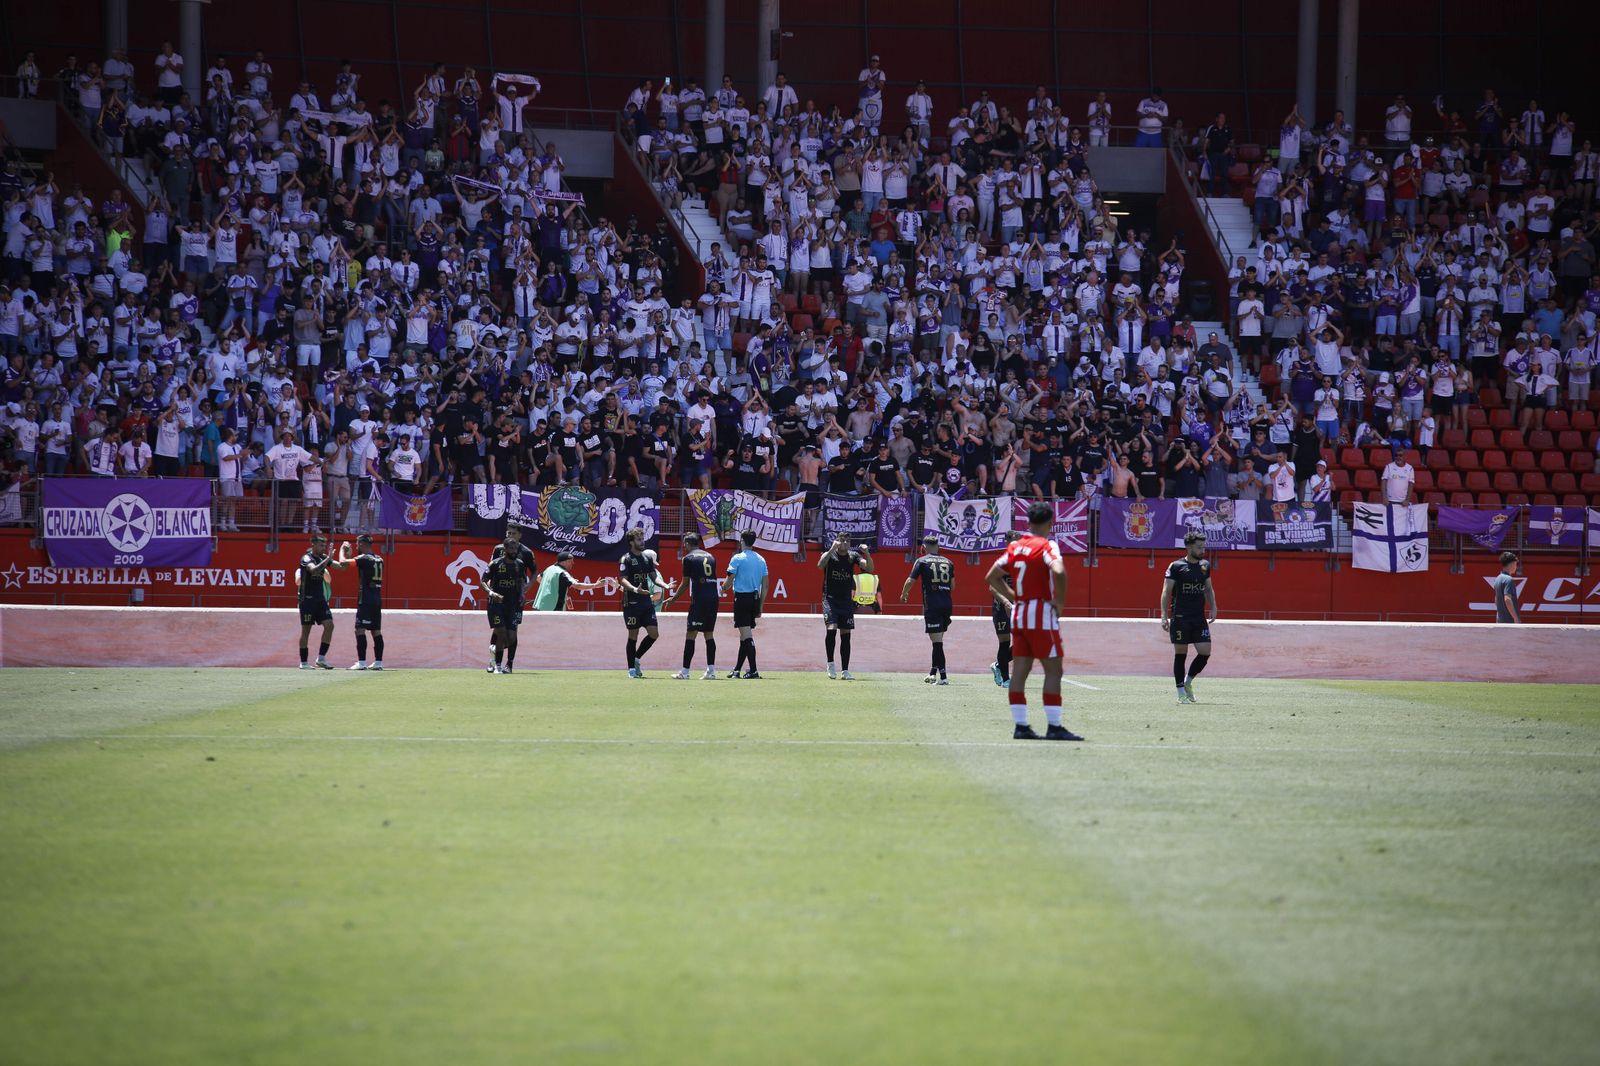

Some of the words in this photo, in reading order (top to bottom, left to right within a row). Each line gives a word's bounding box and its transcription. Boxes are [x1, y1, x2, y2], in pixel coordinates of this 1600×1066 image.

[46, 510, 101, 536] CRUZADA
[155, 510, 209, 536] BLANCA
[599, 497, 655, 544] 06
[543, 525, 587, 544] Hinchas
[882, 537, 909, 546] PRESENTE
[114, 555, 144, 565] 2009
[372, 558, 384, 581] 11
[703, 557, 712, 577] 6
[27, 567, 152, 585] ESTRELLA
[155, 572, 172, 581] DE
[174, 568, 286, 587] LEVANTE
[930, 562, 951, 584] 18
[1013, 560, 1027, 597] 7
[1175, 630, 1182, 641] 3
